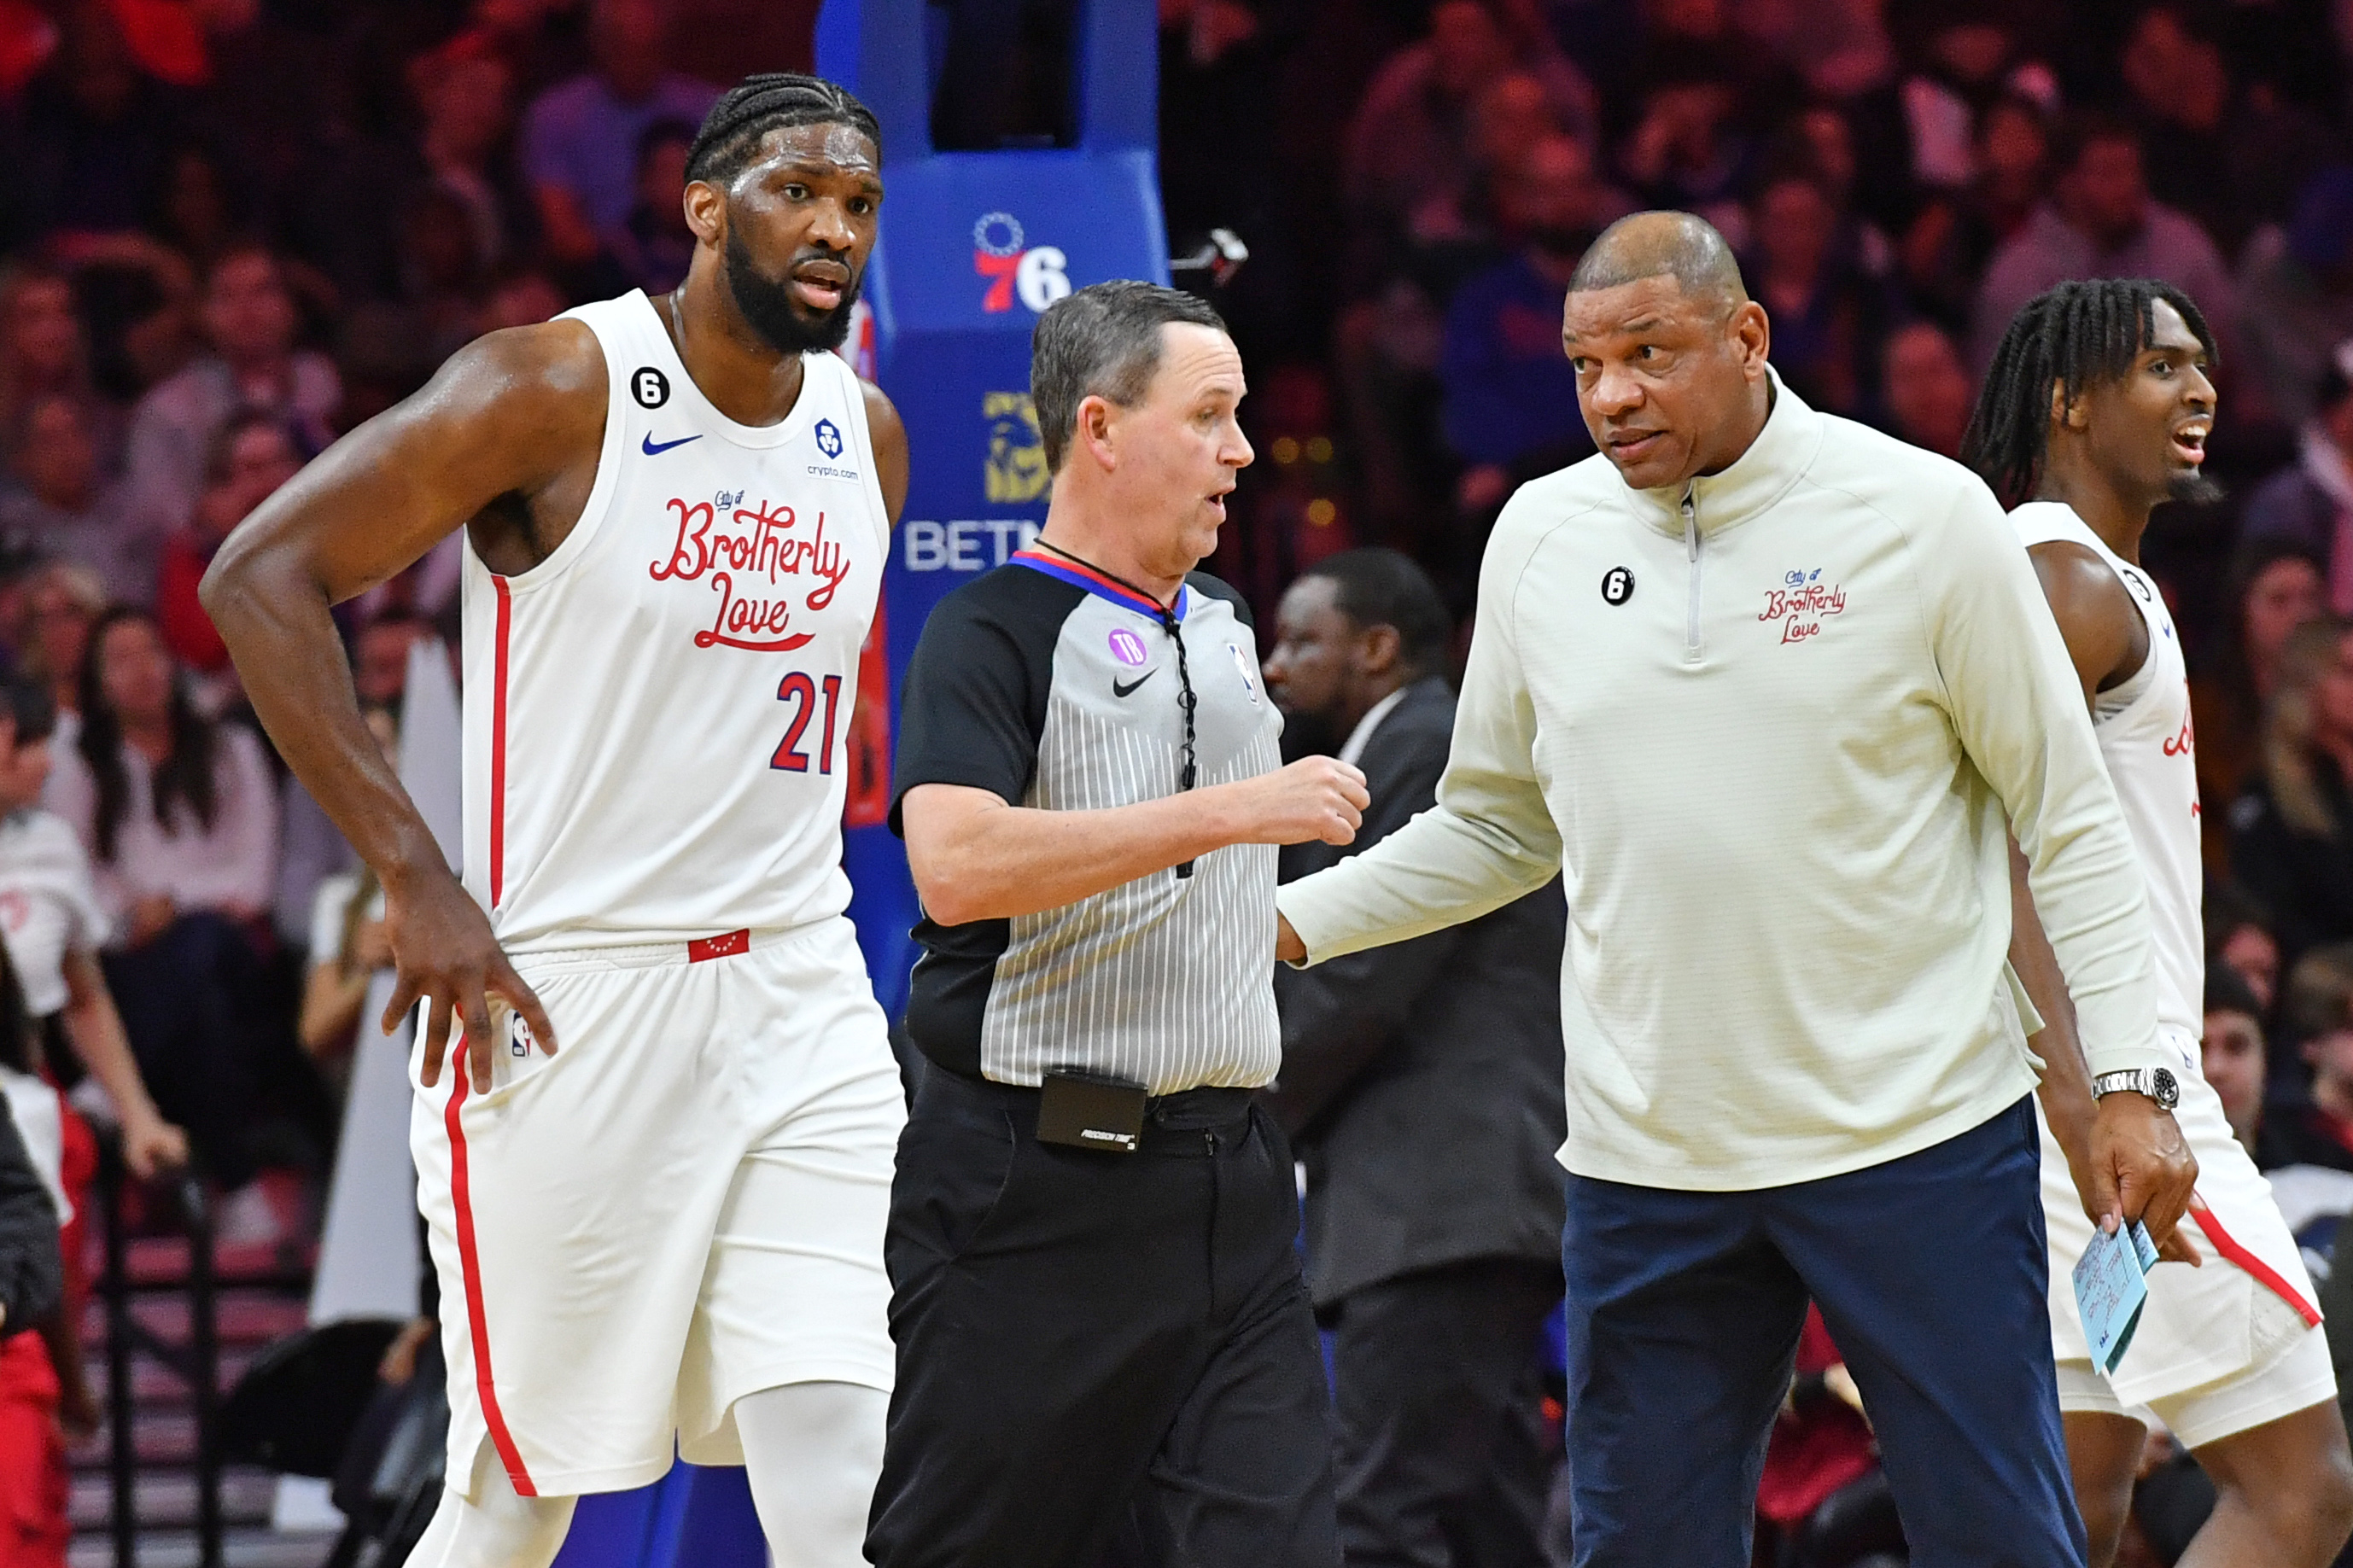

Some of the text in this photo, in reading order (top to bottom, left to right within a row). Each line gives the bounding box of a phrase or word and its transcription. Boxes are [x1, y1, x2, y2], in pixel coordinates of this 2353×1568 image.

[974, 246, 1072, 313] 76
[639, 372, 663, 405] 6
[807, 465, 859, 481] crypto.com
[715, 489, 745, 512] City of
[649, 498, 850, 611] Brotherly
[1606, 571, 1626, 600] 6
[1784, 568, 1822, 589] City of
[693, 572, 816, 652] Love
[1759, 584, 1847, 621] Brotherly
[1781, 615, 1820, 645] Love
[769, 671, 843, 775] 21
